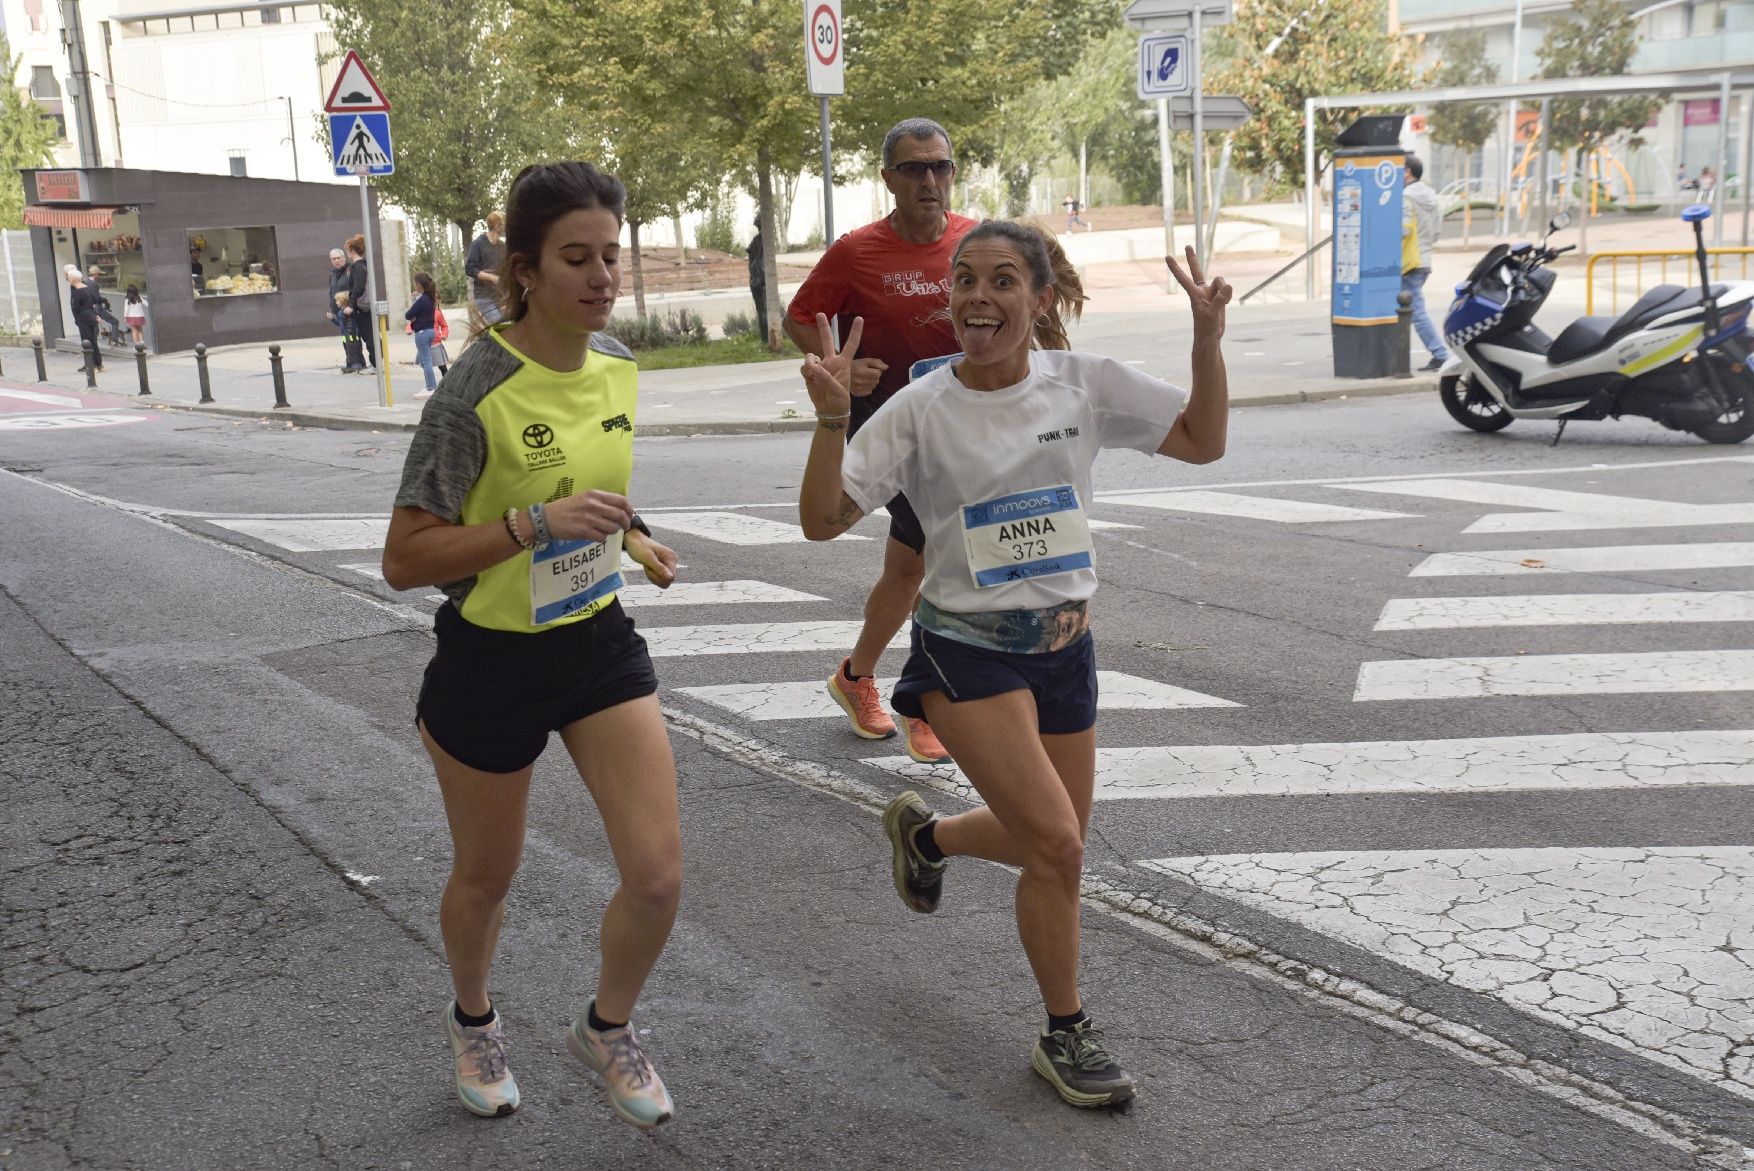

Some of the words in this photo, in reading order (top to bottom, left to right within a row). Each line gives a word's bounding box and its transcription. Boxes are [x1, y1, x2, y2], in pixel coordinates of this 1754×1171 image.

[817, 24, 833, 44] 30
[883, 271, 923, 283] GRUP
[524, 447, 563, 461] TOYOTA
[999, 517, 1056, 542] ANNA
[552, 540, 608, 575] ELISABET
[1012, 539, 1048, 561] 373
[571, 568, 595, 592] 391
